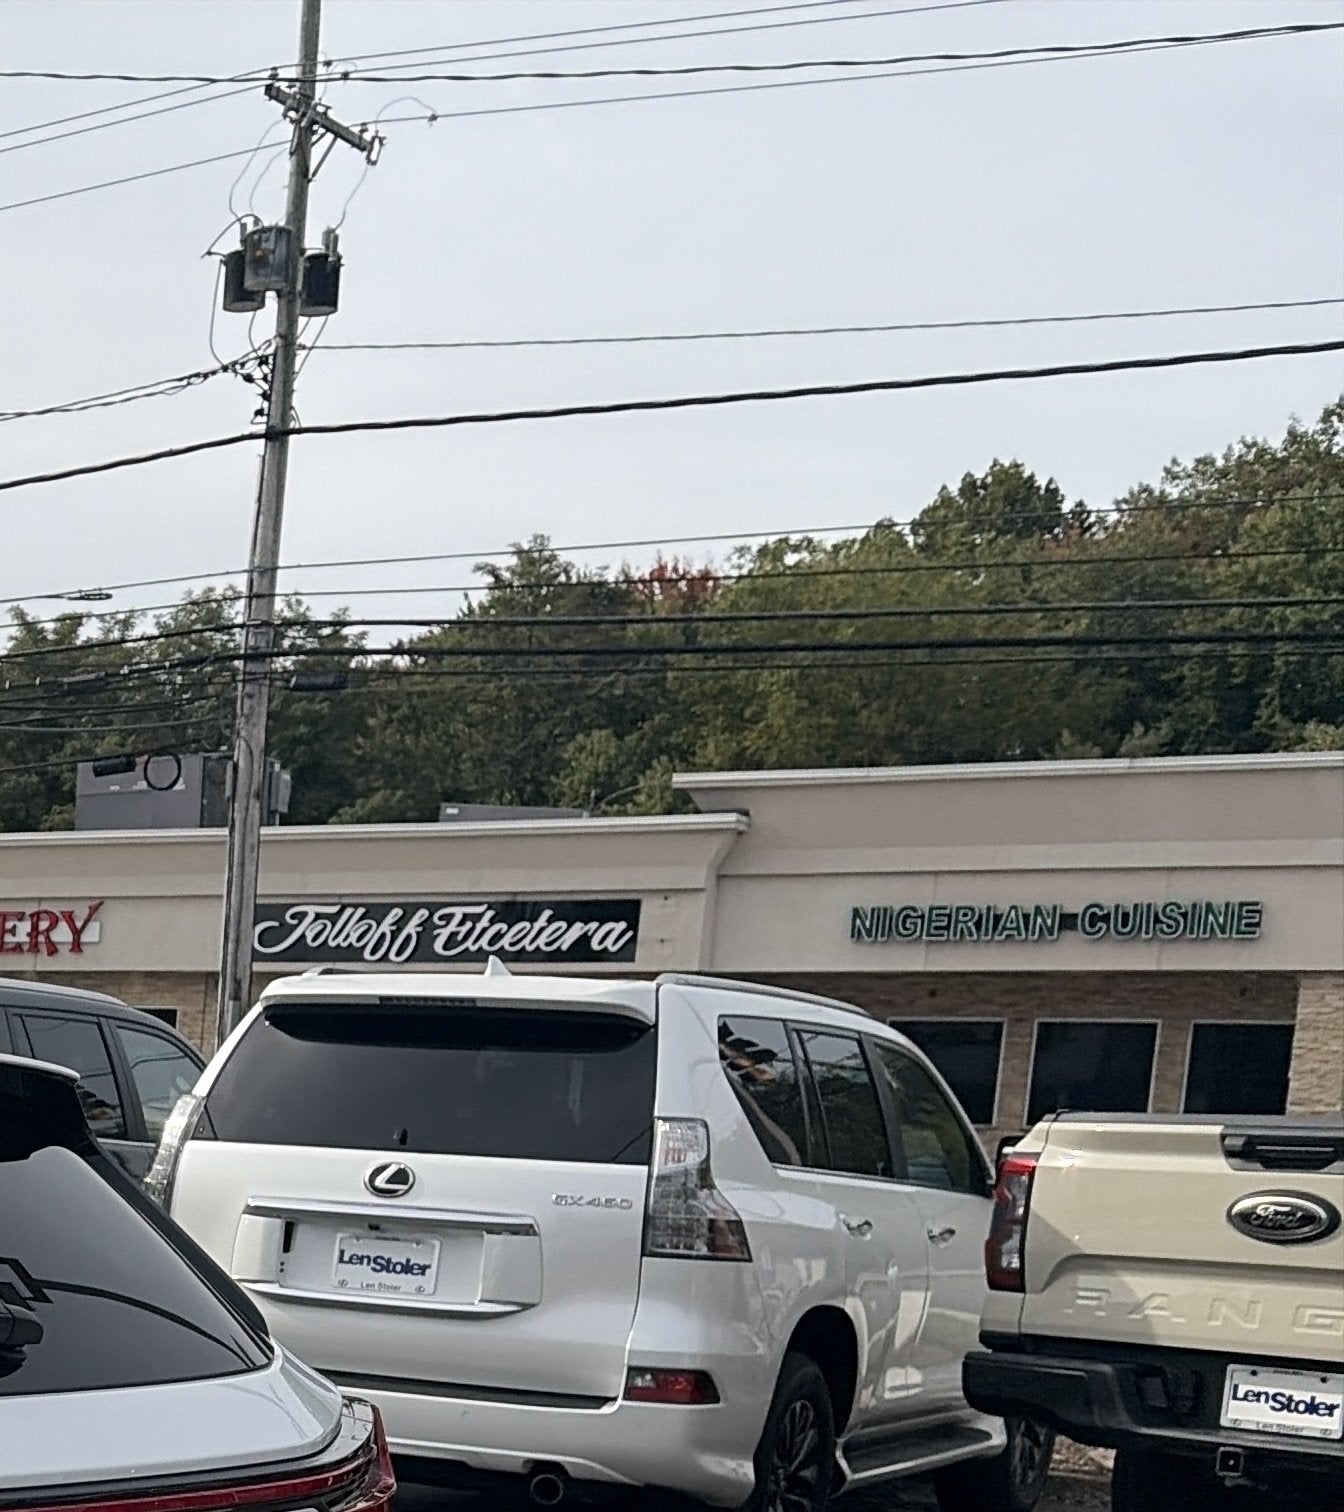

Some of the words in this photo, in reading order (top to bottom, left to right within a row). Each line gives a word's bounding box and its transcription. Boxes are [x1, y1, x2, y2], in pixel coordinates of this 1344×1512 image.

[432, 903, 635, 957] Etcetera
[849, 902, 1061, 942] NIGERIAN
[1077, 899, 1264, 939] CUISINE
